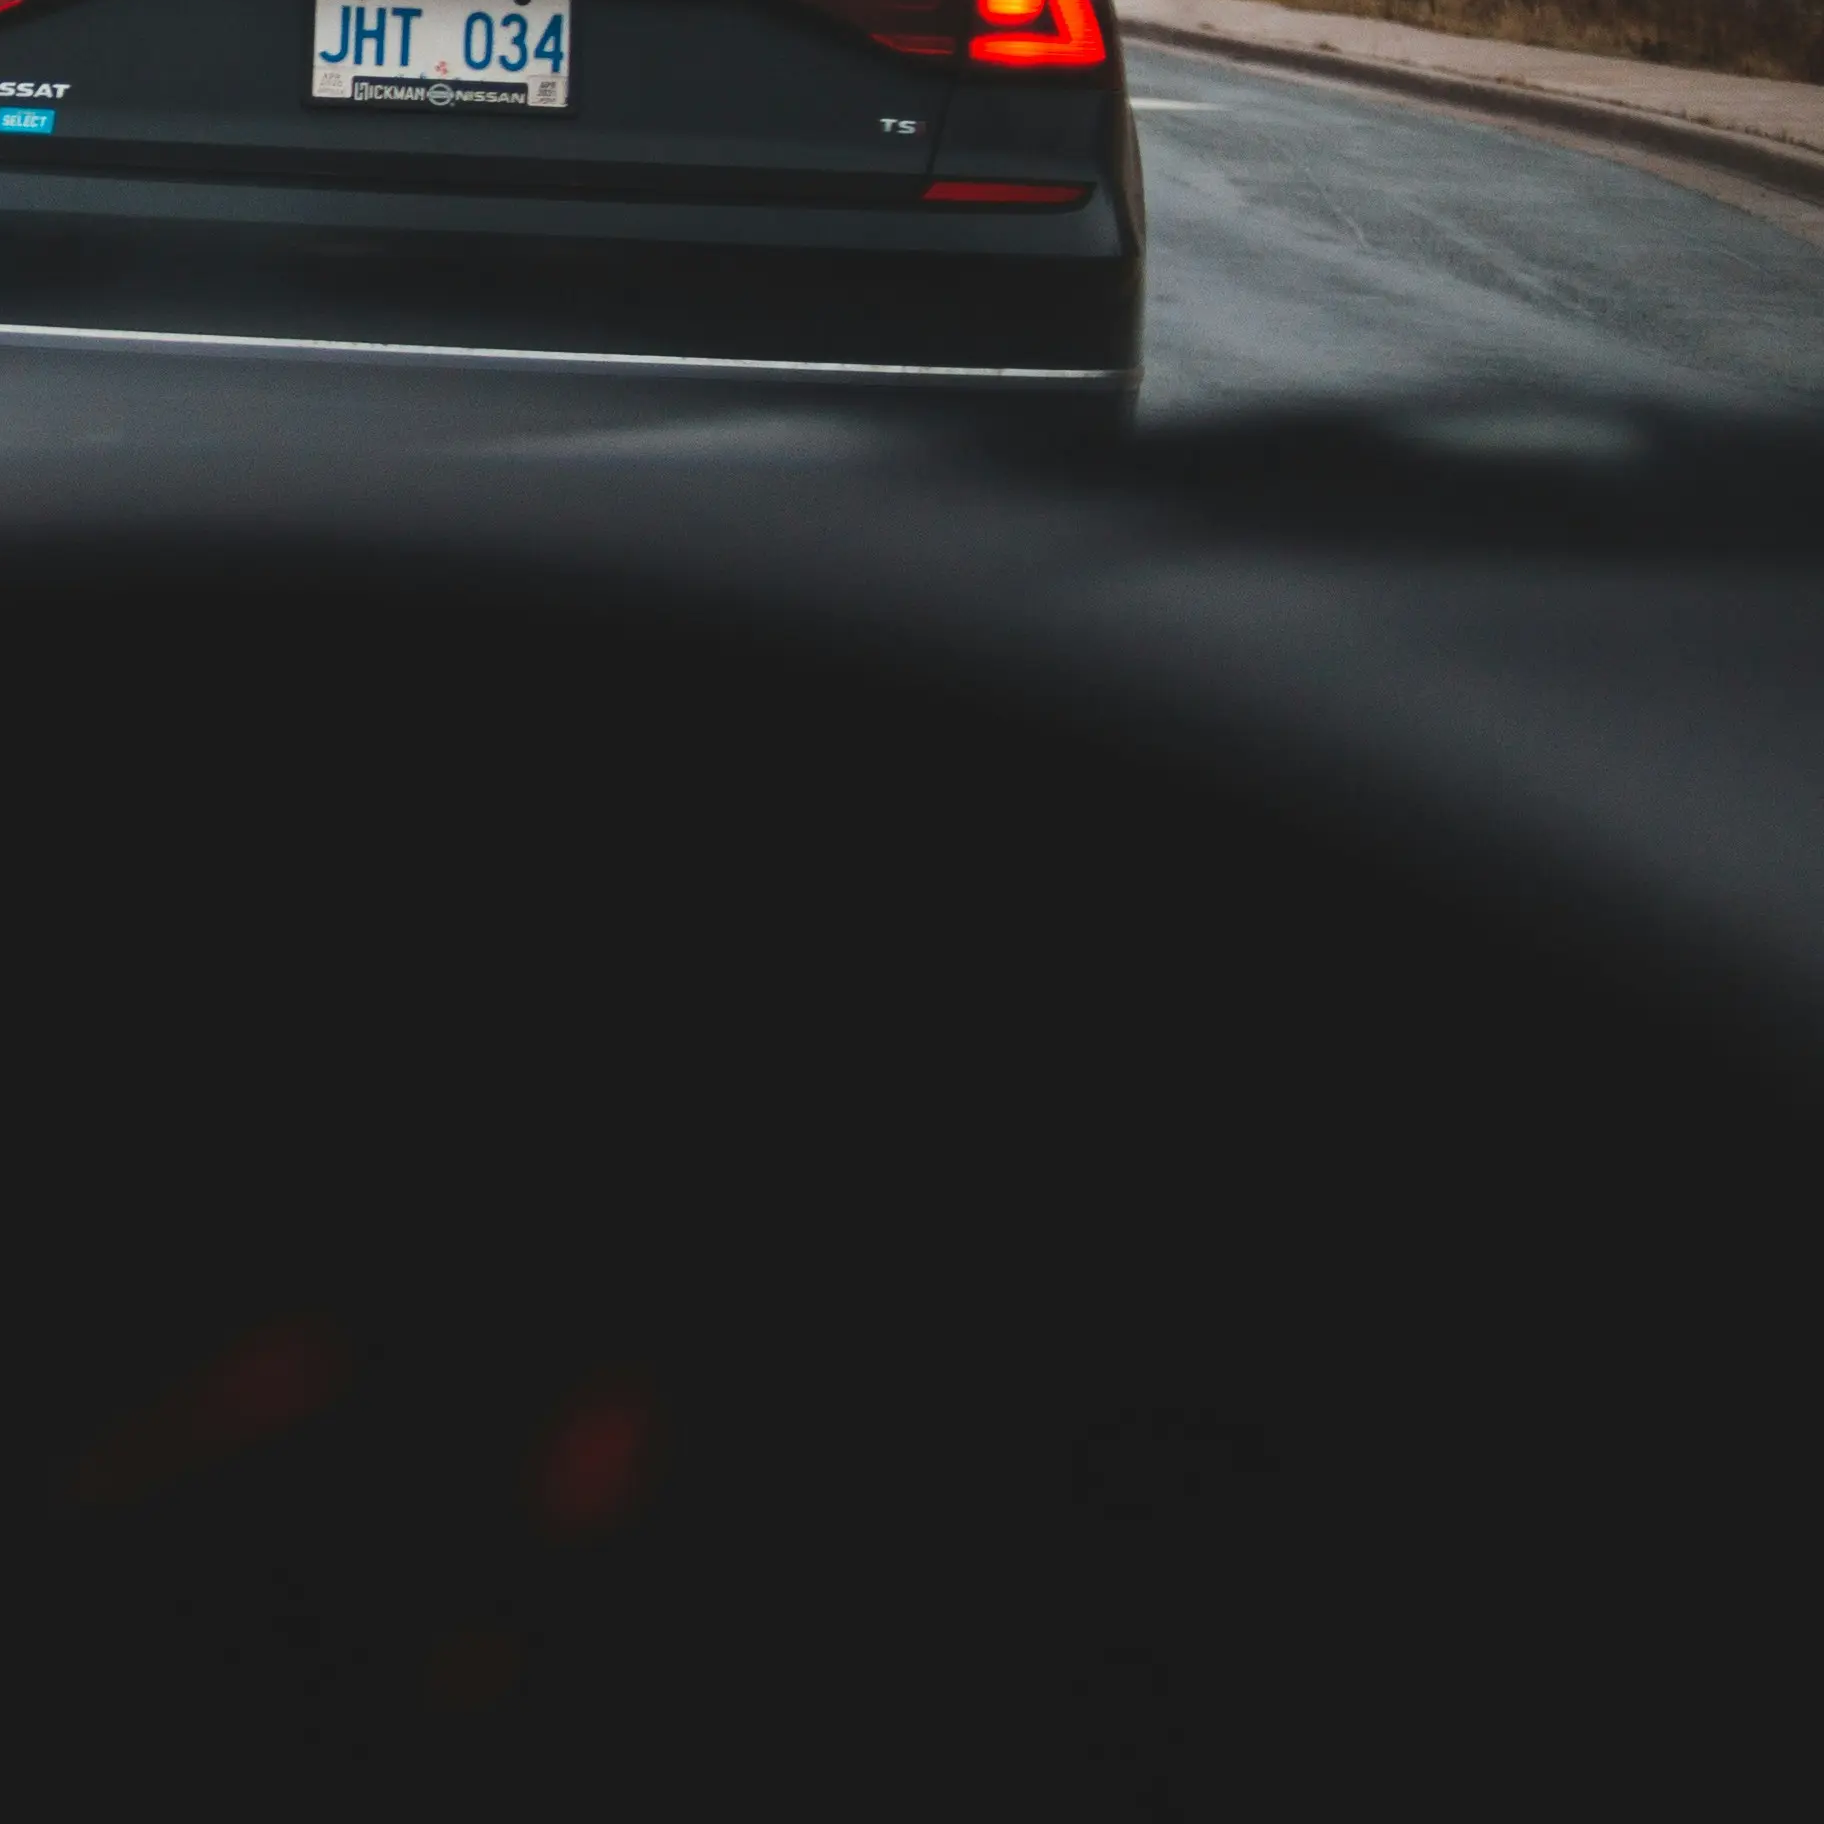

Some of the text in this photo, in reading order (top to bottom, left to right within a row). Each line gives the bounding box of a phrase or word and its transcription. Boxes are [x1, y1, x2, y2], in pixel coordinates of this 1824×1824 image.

[319, 5, 565, 73] JHT 034
[354, 82, 426, 101] HICKMAN
[455, 90, 526, 104] NISSAN
[2, 114, 48, 128] SELECT
